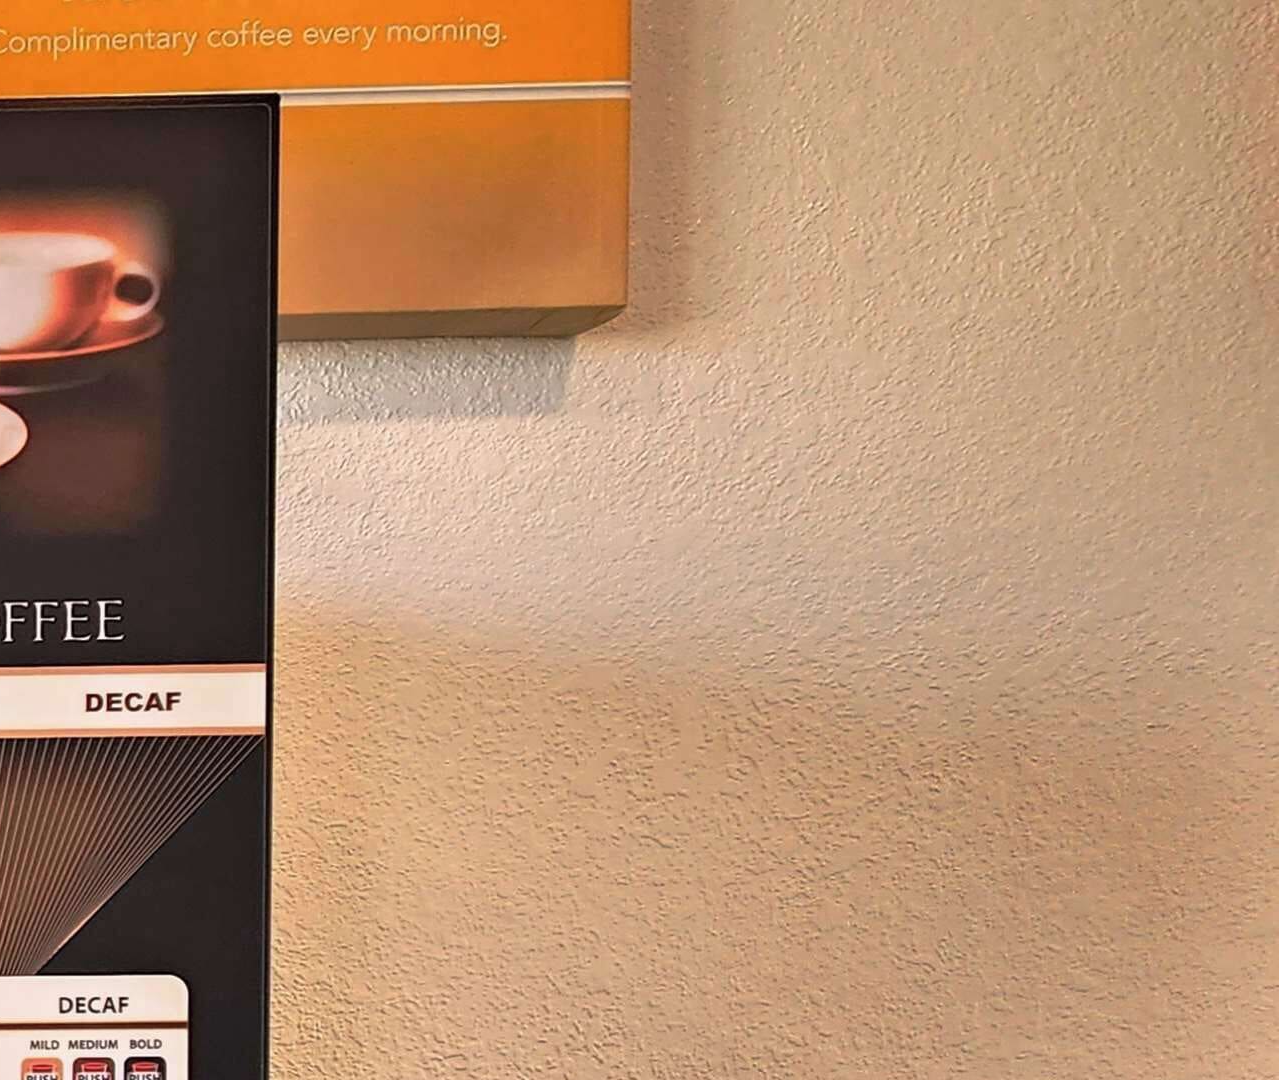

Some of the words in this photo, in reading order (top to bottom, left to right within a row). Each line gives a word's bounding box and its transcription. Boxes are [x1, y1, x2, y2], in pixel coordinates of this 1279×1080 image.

[206, 20, 294, 49] coffee
[303, 27, 377, 51] every
[386, 17, 508, 48] morning.
[85, 691, 182, 714] DECAF
[57, 995, 130, 1015] DECAF
[29, 1039, 60, 1051] MILD
[67, 1039, 119, 1050] MEDIUM
[129, 1038, 163, 1050] BOLD
